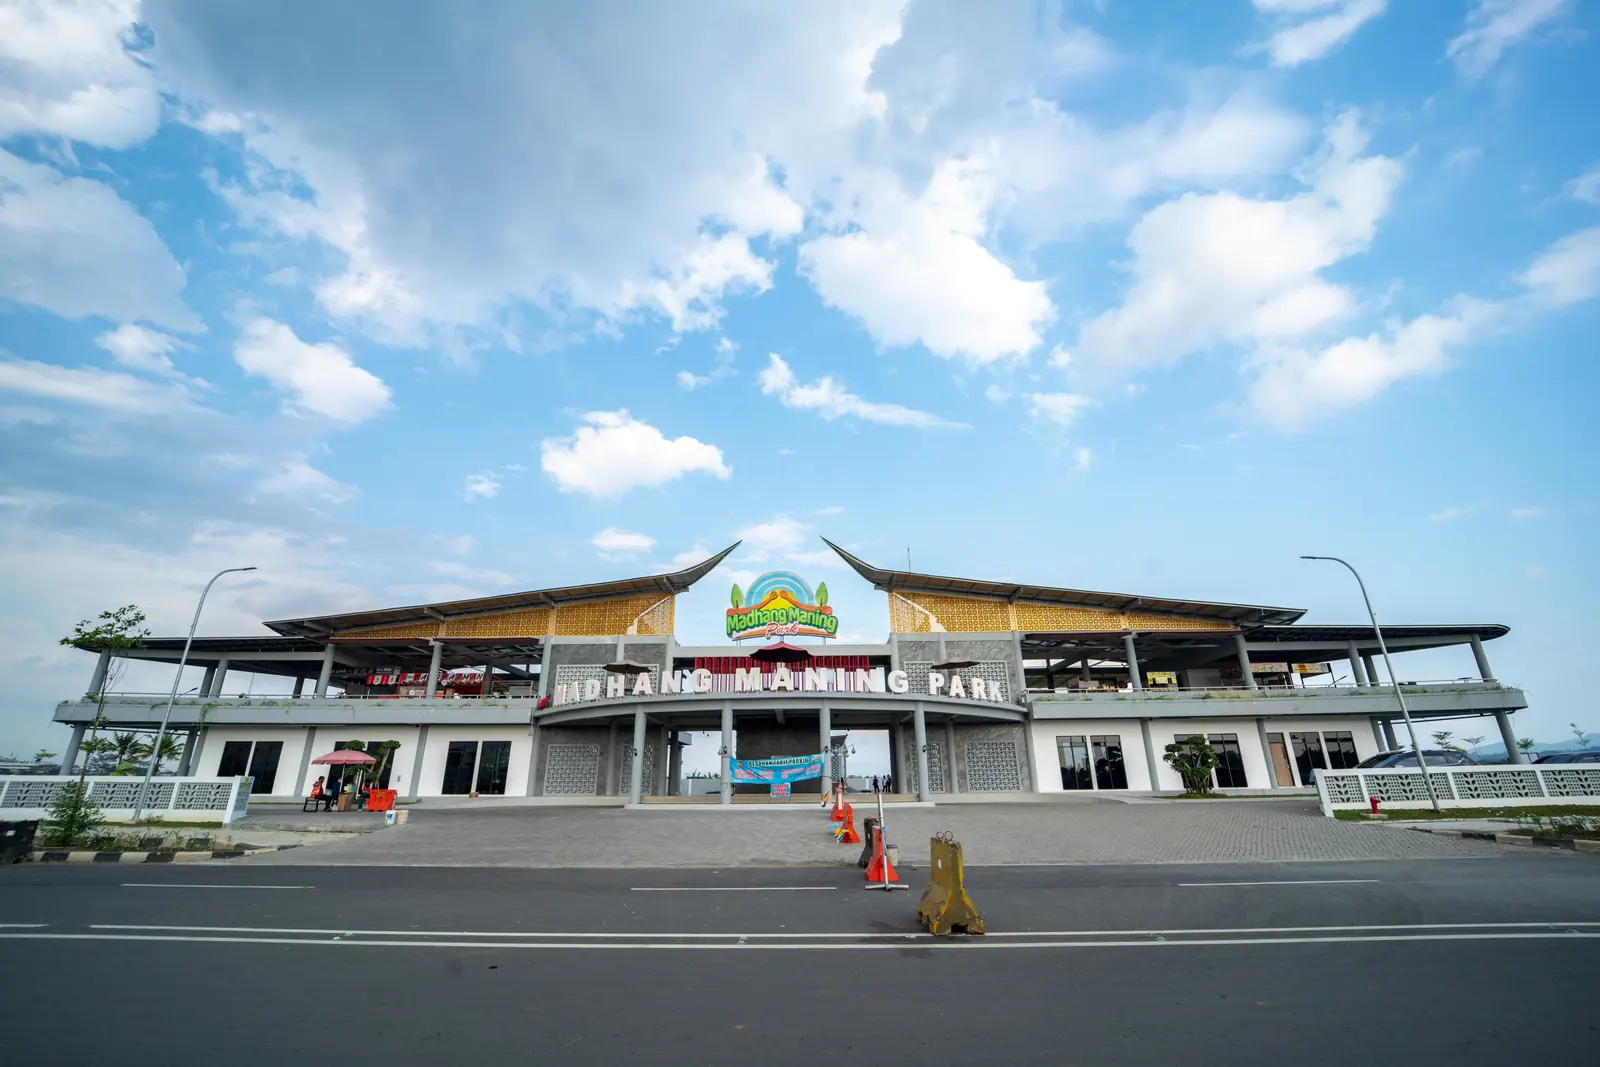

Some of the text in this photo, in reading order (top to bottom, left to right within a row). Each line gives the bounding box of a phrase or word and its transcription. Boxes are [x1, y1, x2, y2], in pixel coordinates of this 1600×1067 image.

[726, 607, 838, 638] Madhang Maning
[766, 622, 799, 639] Park
[735, 667, 908, 694] MANING
[928, 672, 1003, 702] PARK
